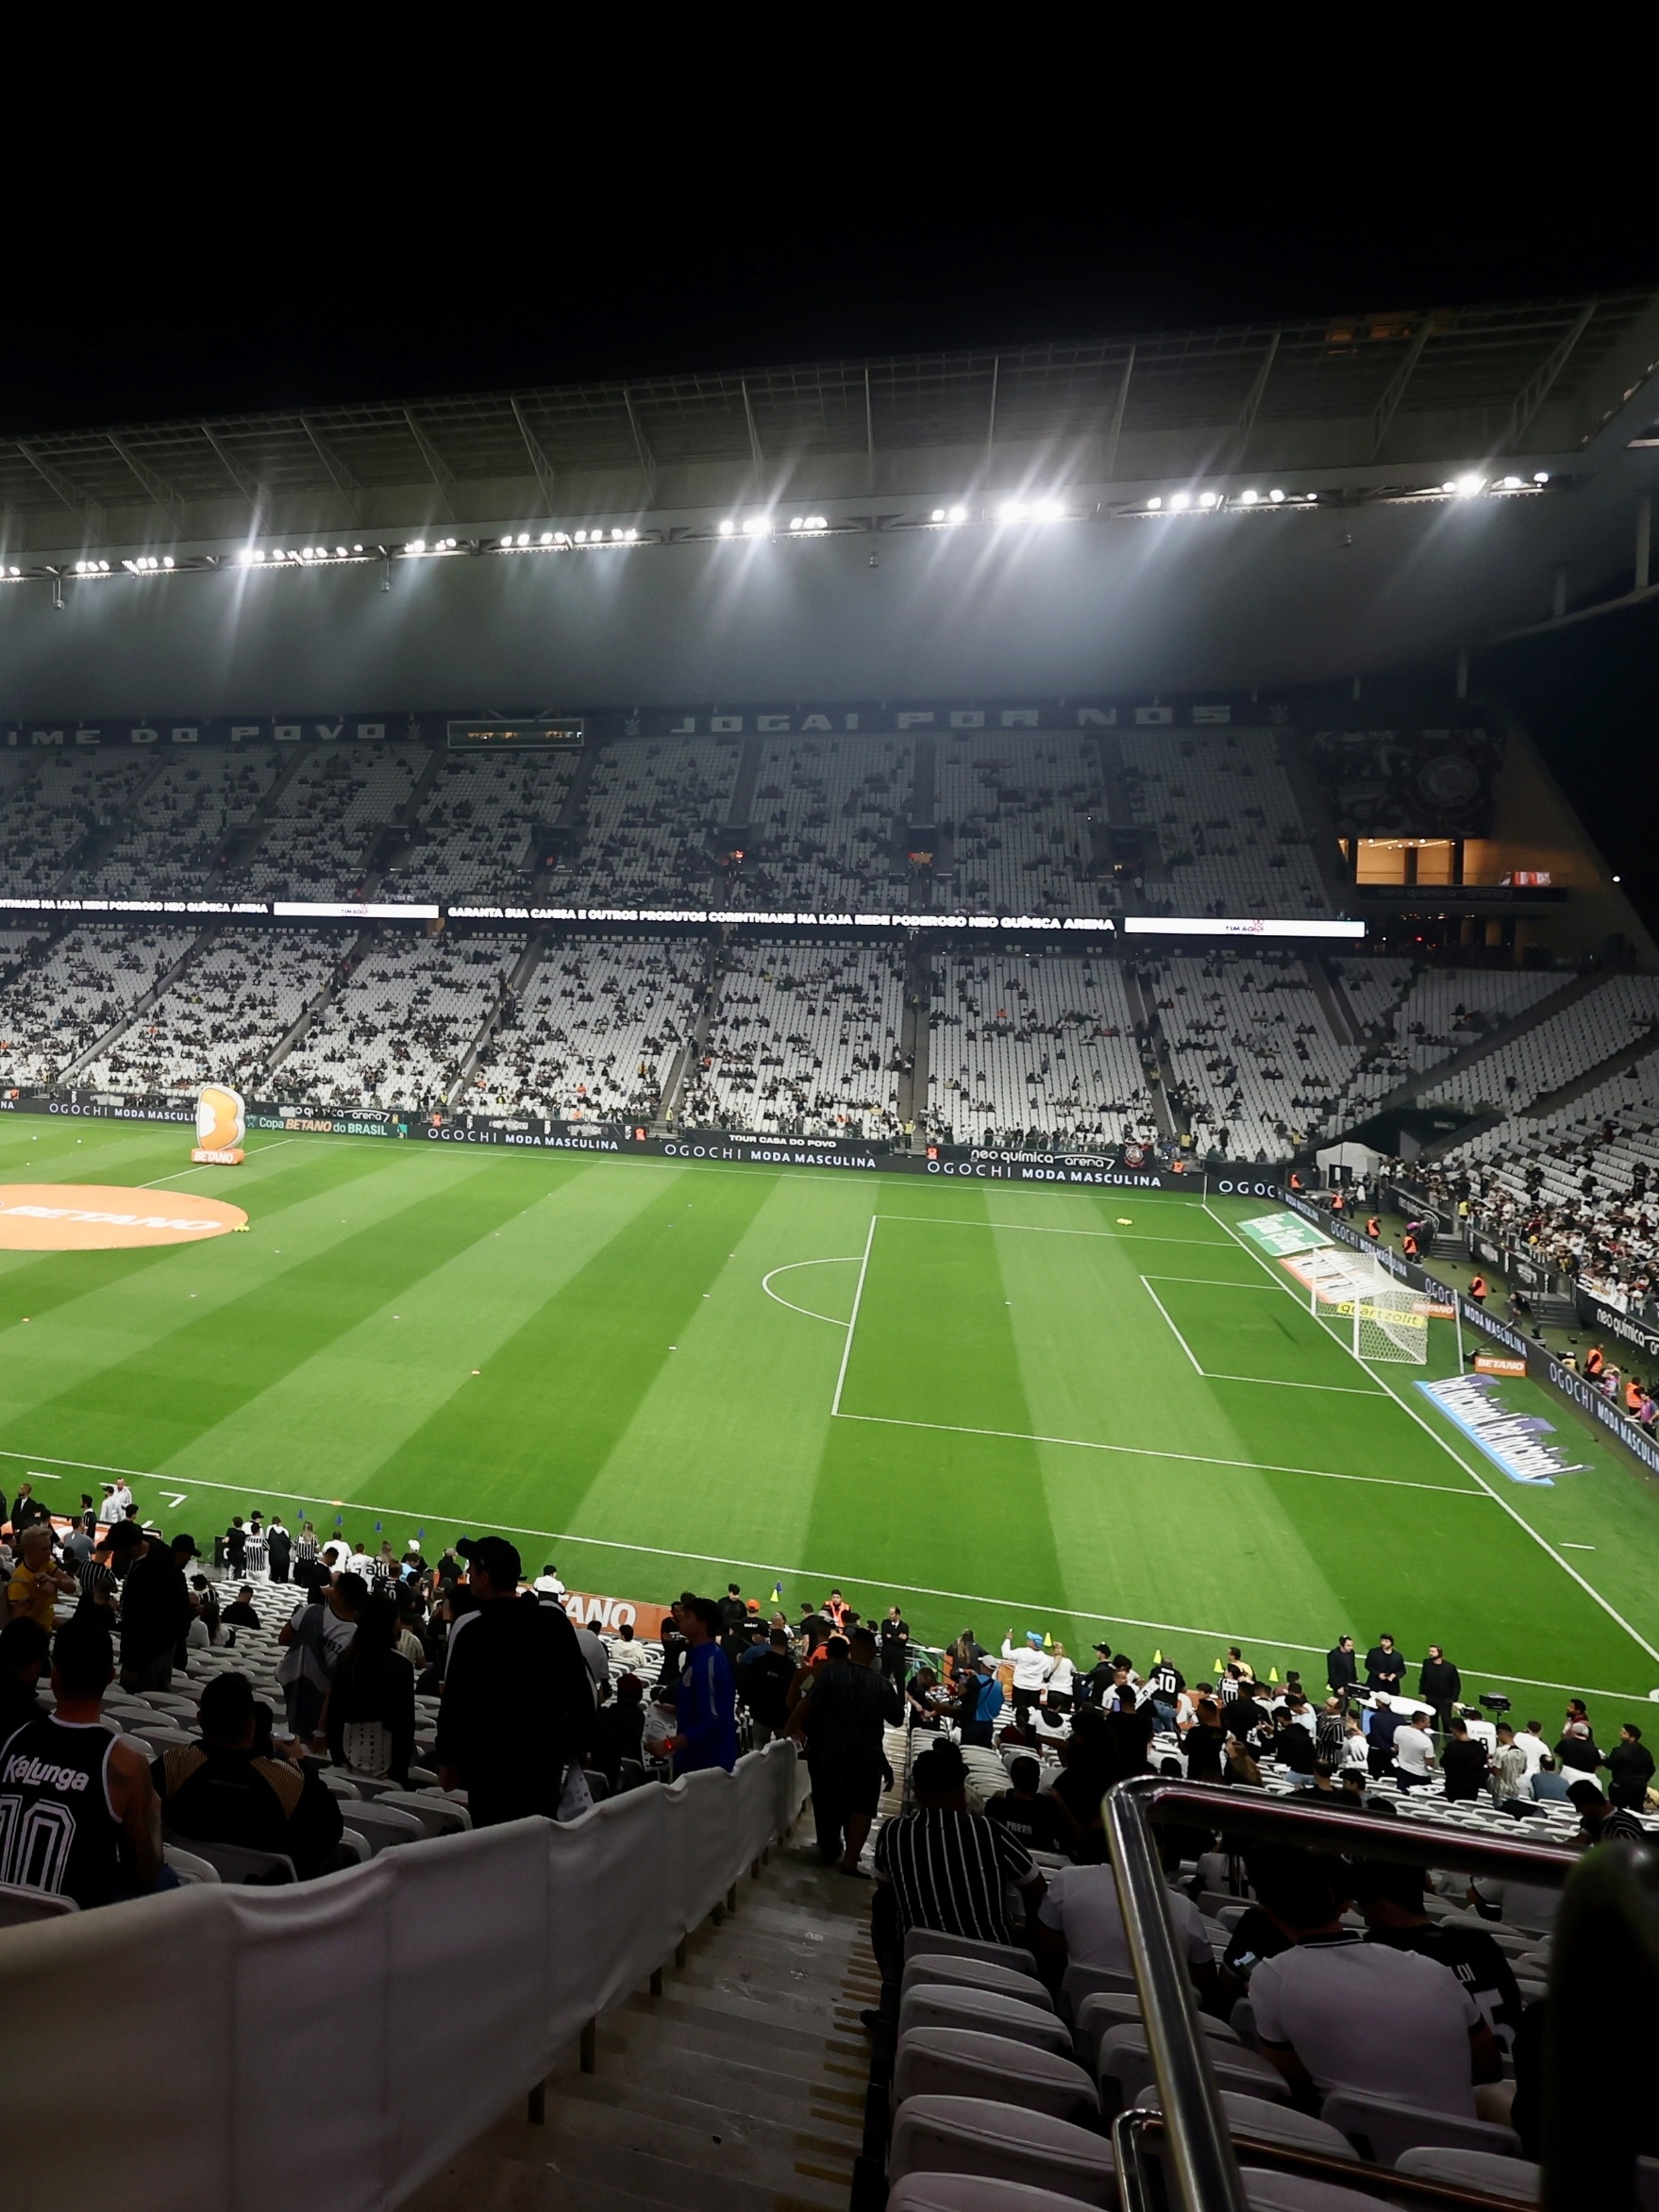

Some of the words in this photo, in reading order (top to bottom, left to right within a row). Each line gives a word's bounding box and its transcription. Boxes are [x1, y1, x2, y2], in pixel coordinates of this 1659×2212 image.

[131, 728, 198, 744] DO
[231, 724, 385, 742] POVO
[42, 900, 56, 909] NA
[57, 900, 81, 910] LOJA
[82, 900, 109, 911] REDE
[109, 901, 163, 912] PODEROSO
[164, 902, 186, 912] NEO
[231, 903, 268, 913] ARENA
[448, 907, 503, 918] GARANTA
[504, 908, 529, 918] SUA
[530, 909, 577, 920] CAMISA
[578, 910, 587, 920] E
[588, 910, 638, 921] OUTROS
[639, 911, 707, 922] PRODUTOS
[708, 912, 796, 924] CORINTHIANS
[797, 913, 817, 924] NA
[818, 913, 853, 925] LOJA
[854, 914, 891, 926] REDE
[892, 914, 967, 928] PODEROSO
[968, 916, 999, 928] NEO
[1000, 915, 1061, 930] QUÍMICA
[1063, 918, 1114, 930] ARENA
[49, 1102, 108, 1117] OGOCHI
[114, 1108, 145, 1118] MODA
[259, 1117, 284, 1130] Copa
[285, 1118, 332, 1131] BETANO
[333, 1122, 346, 1132] do
[347, 1123, 388, 1136] BRASIL
[427, 1128, 497, 1144] OGOCHI
[505, 1134, 542, 1146] MODA
[545, 1137, 619, 1150] MASCULINA
[729, 1134, 757, 1144] TOUR
[759, 1136, 788, 1146] CASA
[790, 1138, 805, 1147] DO
[807, 1139, 837, 1148] POVO
[193, 1150, 235, 1163] BETANO
[664, 1144, 742, 1160] OGOCHI
[750, 1150, 791, 1163] MODA
[795, 1153, 877, 1168] MASCULINA
[971, 1148, 997, 1161] neo
[1000, 1149, 1054, 1165] química
[927, 1161, 1012, 1179] OGOCHI
[1022, 1167, 1065, 1181] MODA
[1070, 1170, 1162, 1188] MASCULINA
[1, 1204, 223, 1231] BETANO
[1331, 1220, 1359, 1248] OGOCHI
[1464, 1304, 1484, 1328] MODA
[1597, 1308, 1613, 1328] neo
[1613, 1317, 1645, 1348] química
[1477, 1359, 1525, 1371] BETANO
[1550, 1362, 1594, 1413] OGOCHI
[1597, 1401, 1619, 1434] MODA
[1158, 1673, 1177, 1694] 10
